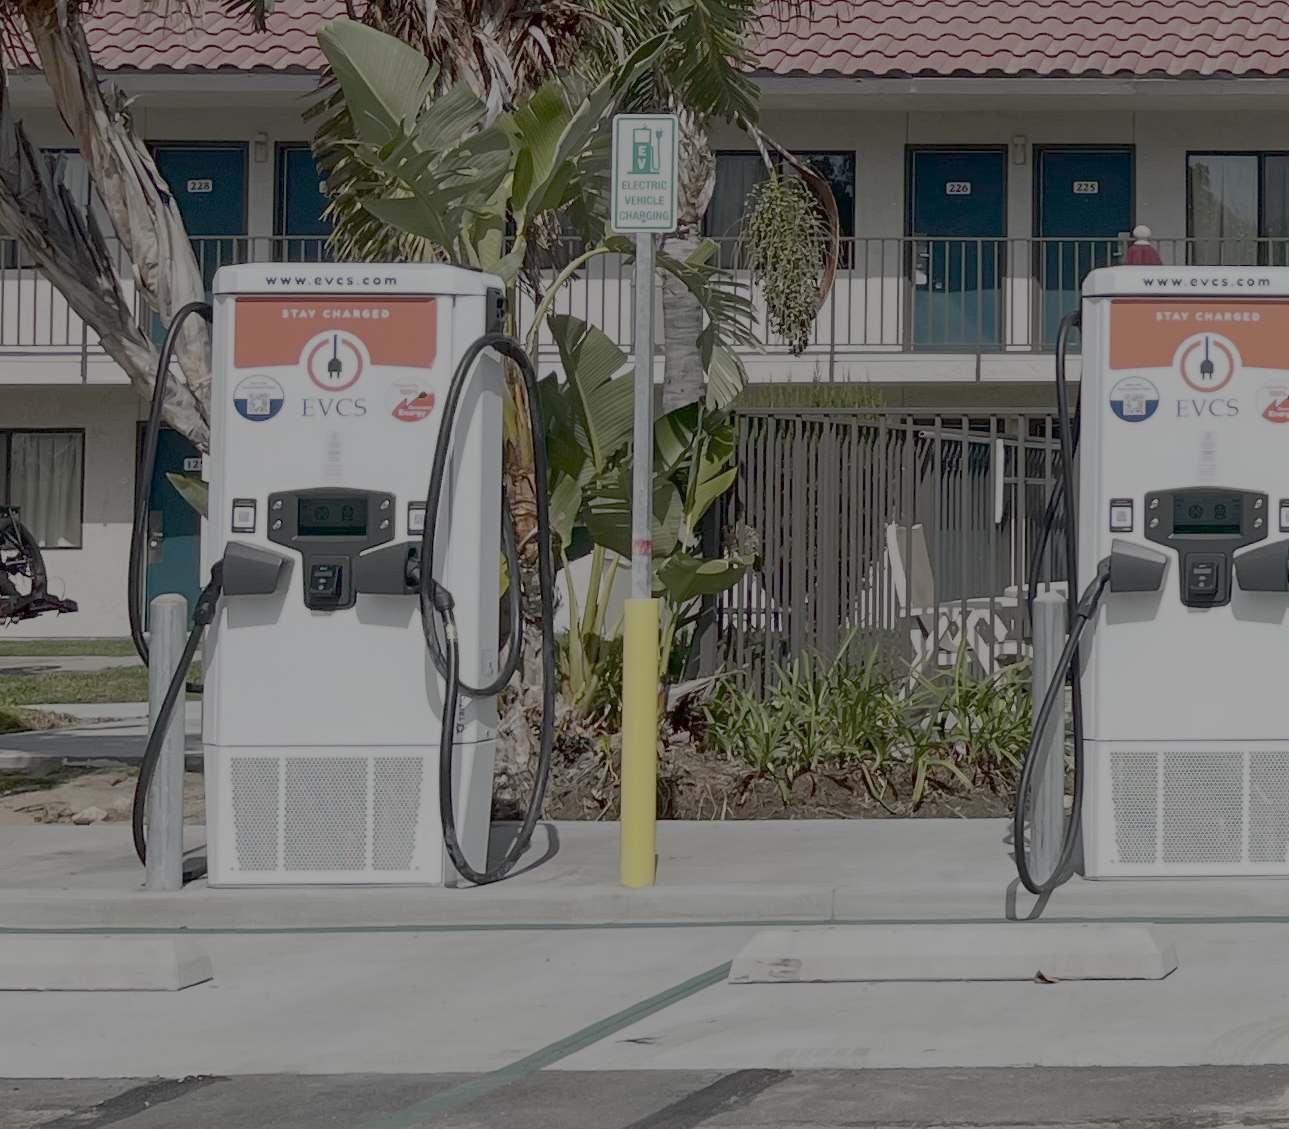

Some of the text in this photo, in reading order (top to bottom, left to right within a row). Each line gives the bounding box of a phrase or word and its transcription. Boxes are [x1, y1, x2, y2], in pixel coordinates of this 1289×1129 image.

[190, 182, 210, 191] 228
[622, 180, 667, 190] ELECTRIC
[949, 184, 969, 193] 226
[1076, 184, 1096, 192] 225
[625, 196, 665, 205] VEHICLE
[619, 211, 669, 221] CHARGING
[265, 276, 398, 286] www.evcs.com
[1143, 278, 1271, 287] www.evcs.com
[281, 309, 390, 319] STAY CHARGED
[1155, 311, 1261, 321] STAY CHARGED
[302, 398, 367, 417] EVCS
[1176, 398, 1239, 418] EVCS
